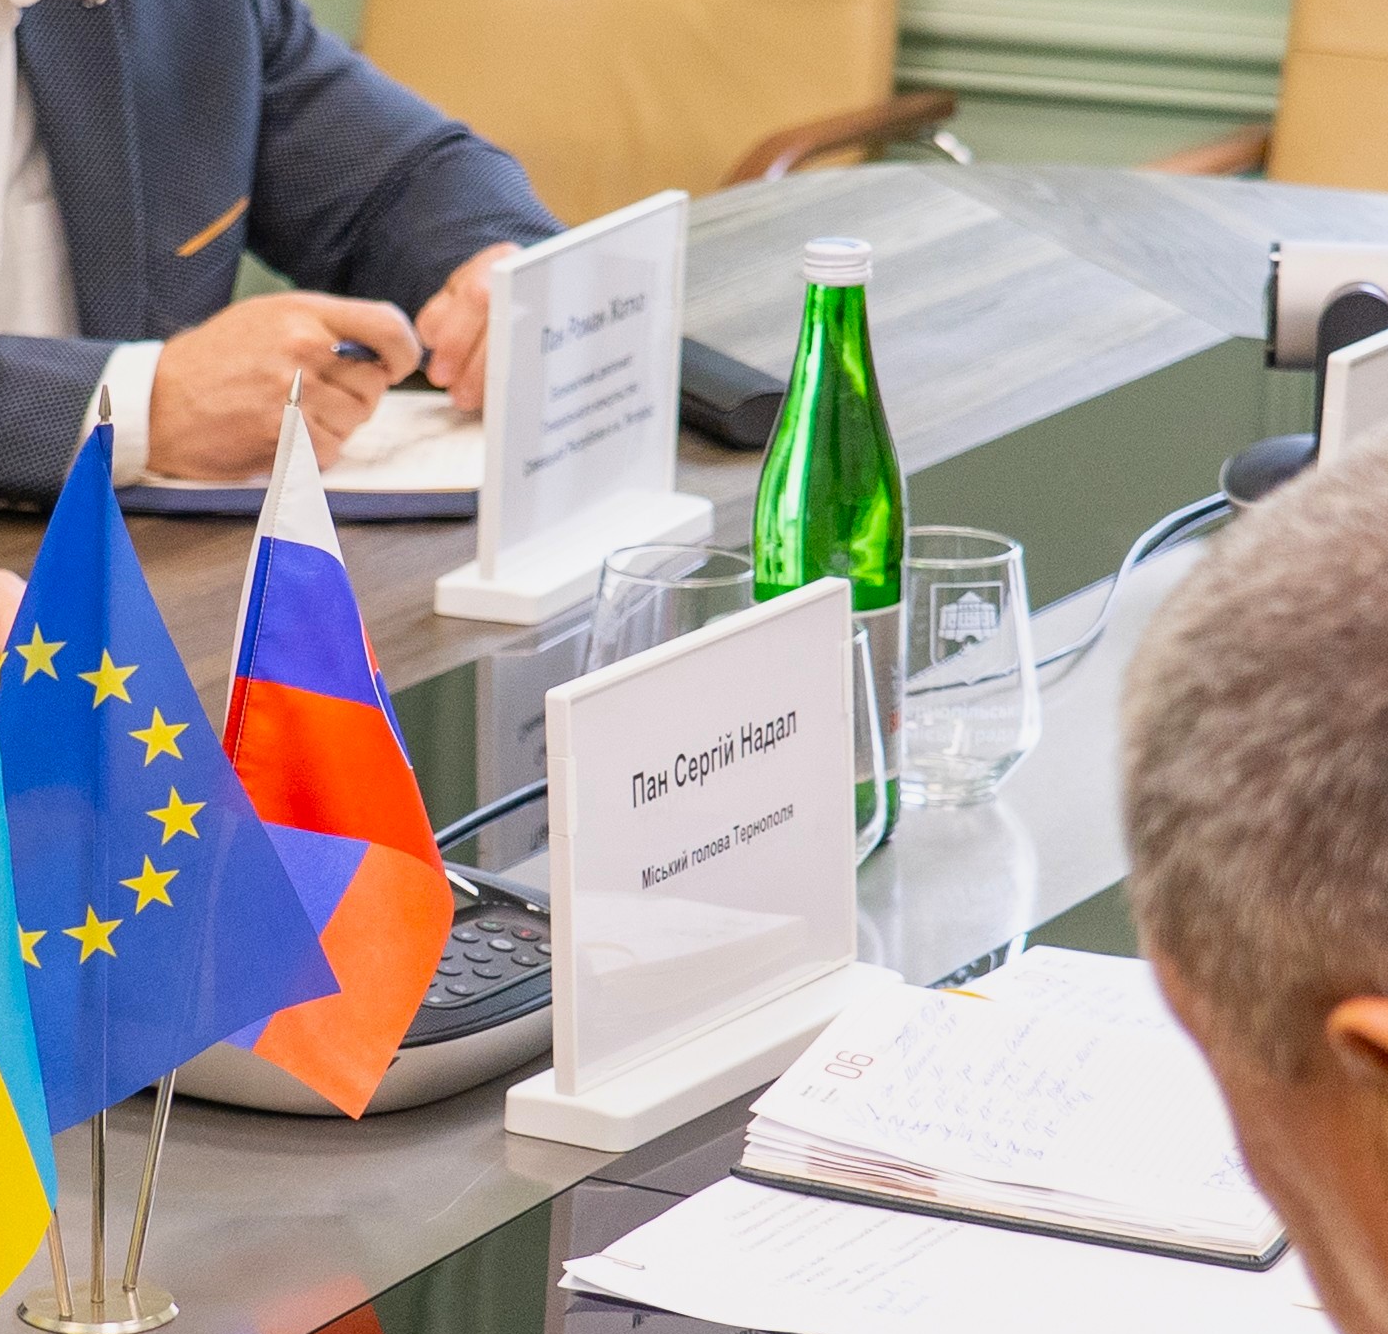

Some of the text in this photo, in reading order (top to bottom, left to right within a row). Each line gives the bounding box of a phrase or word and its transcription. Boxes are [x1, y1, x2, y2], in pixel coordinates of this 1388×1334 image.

[632, 710, 797, 808] Пан Сергій Надал
[642, 803, 794, 890] Міський голова Тернополя
[825, 1050, 874, 1079] 06
